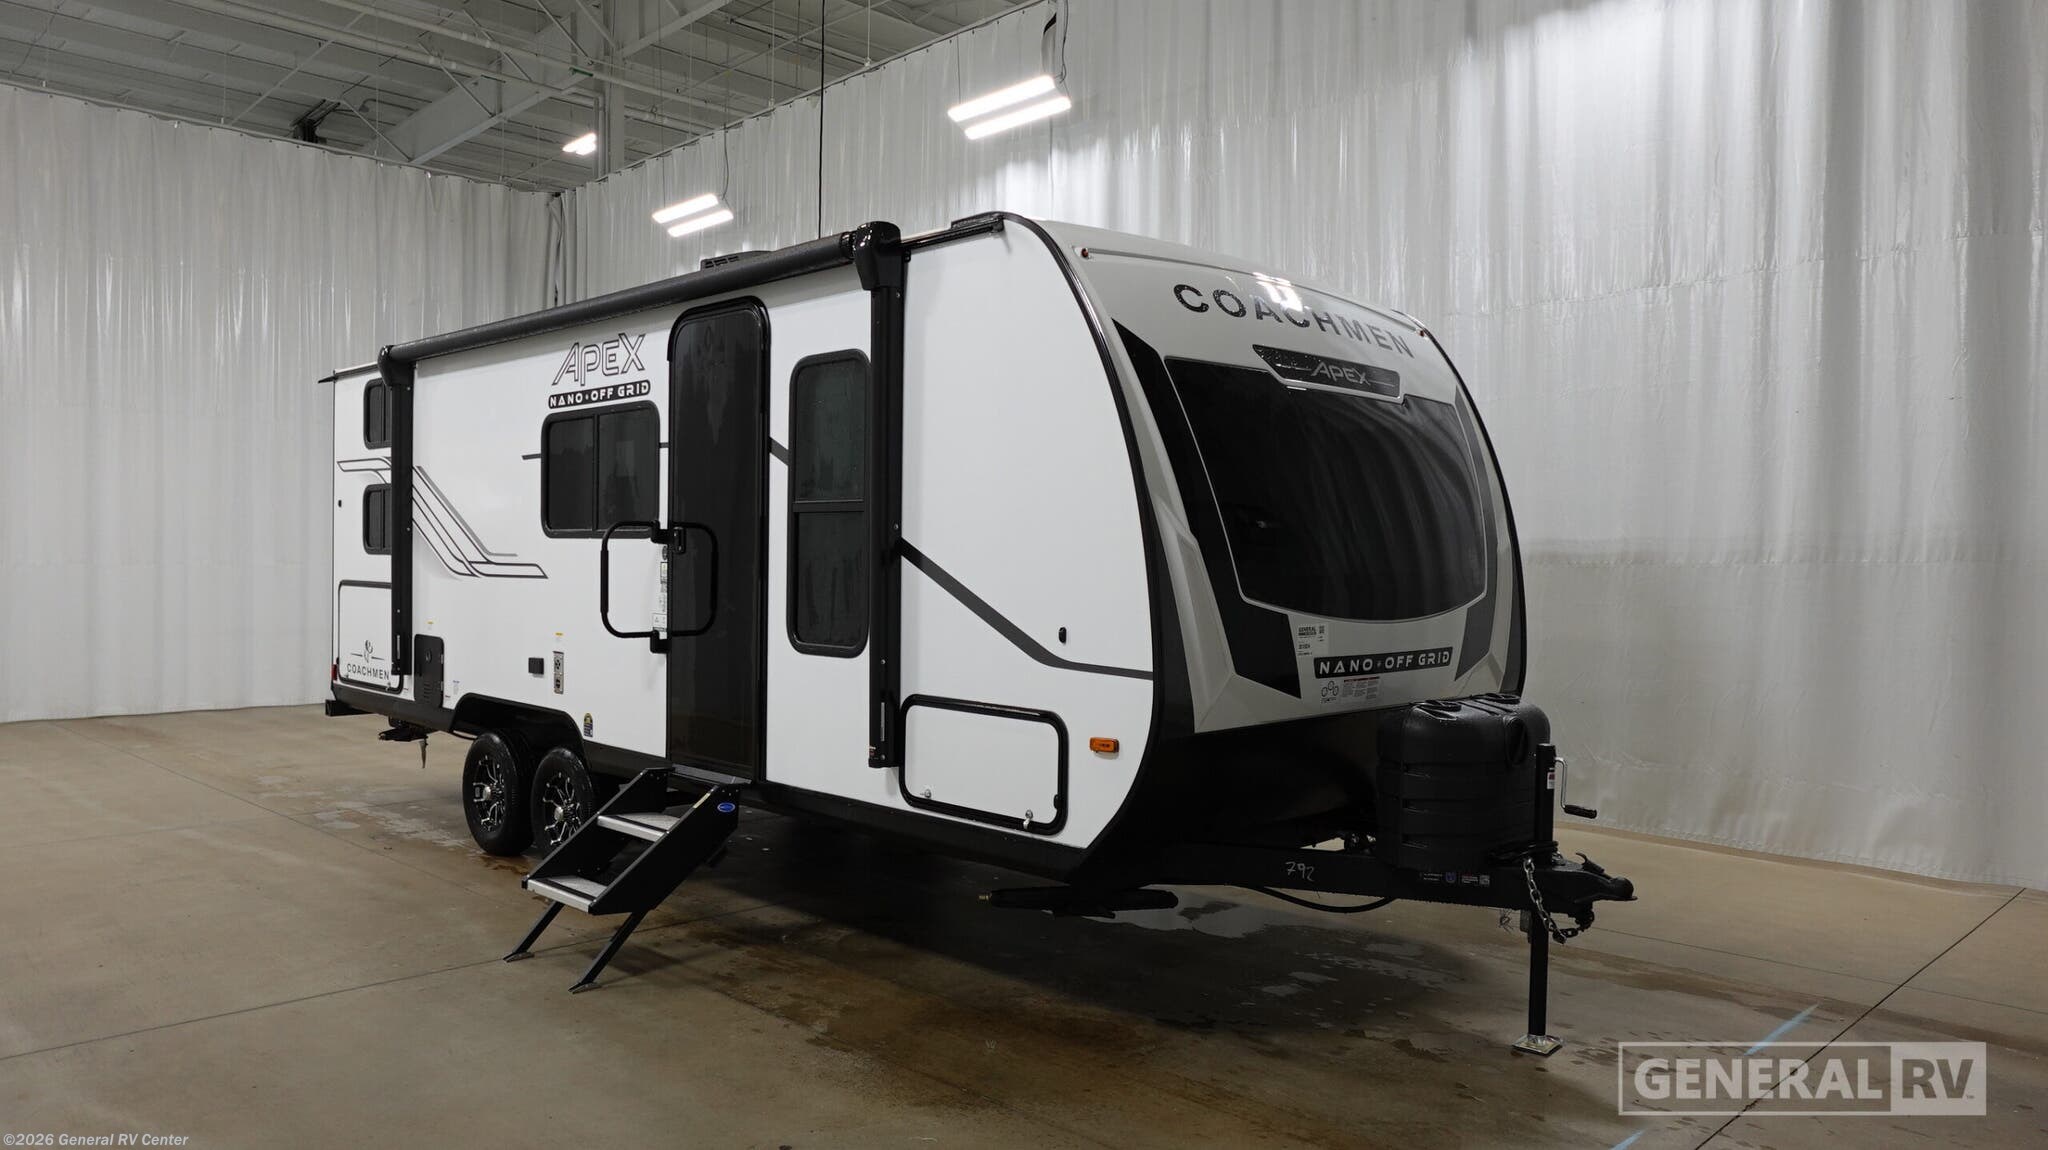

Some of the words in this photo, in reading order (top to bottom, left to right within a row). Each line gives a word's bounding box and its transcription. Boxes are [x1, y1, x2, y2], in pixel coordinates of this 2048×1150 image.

[551, 332, 646, 387] APEX
[1311, 361, 1371, 386] APEX
[617, 381, 650, 397] GRID
[1418, 650, 1450, 666] GRID
[346, 663, 390, 681] COACHMEN
[1285, 861, 1315, 882] 792
